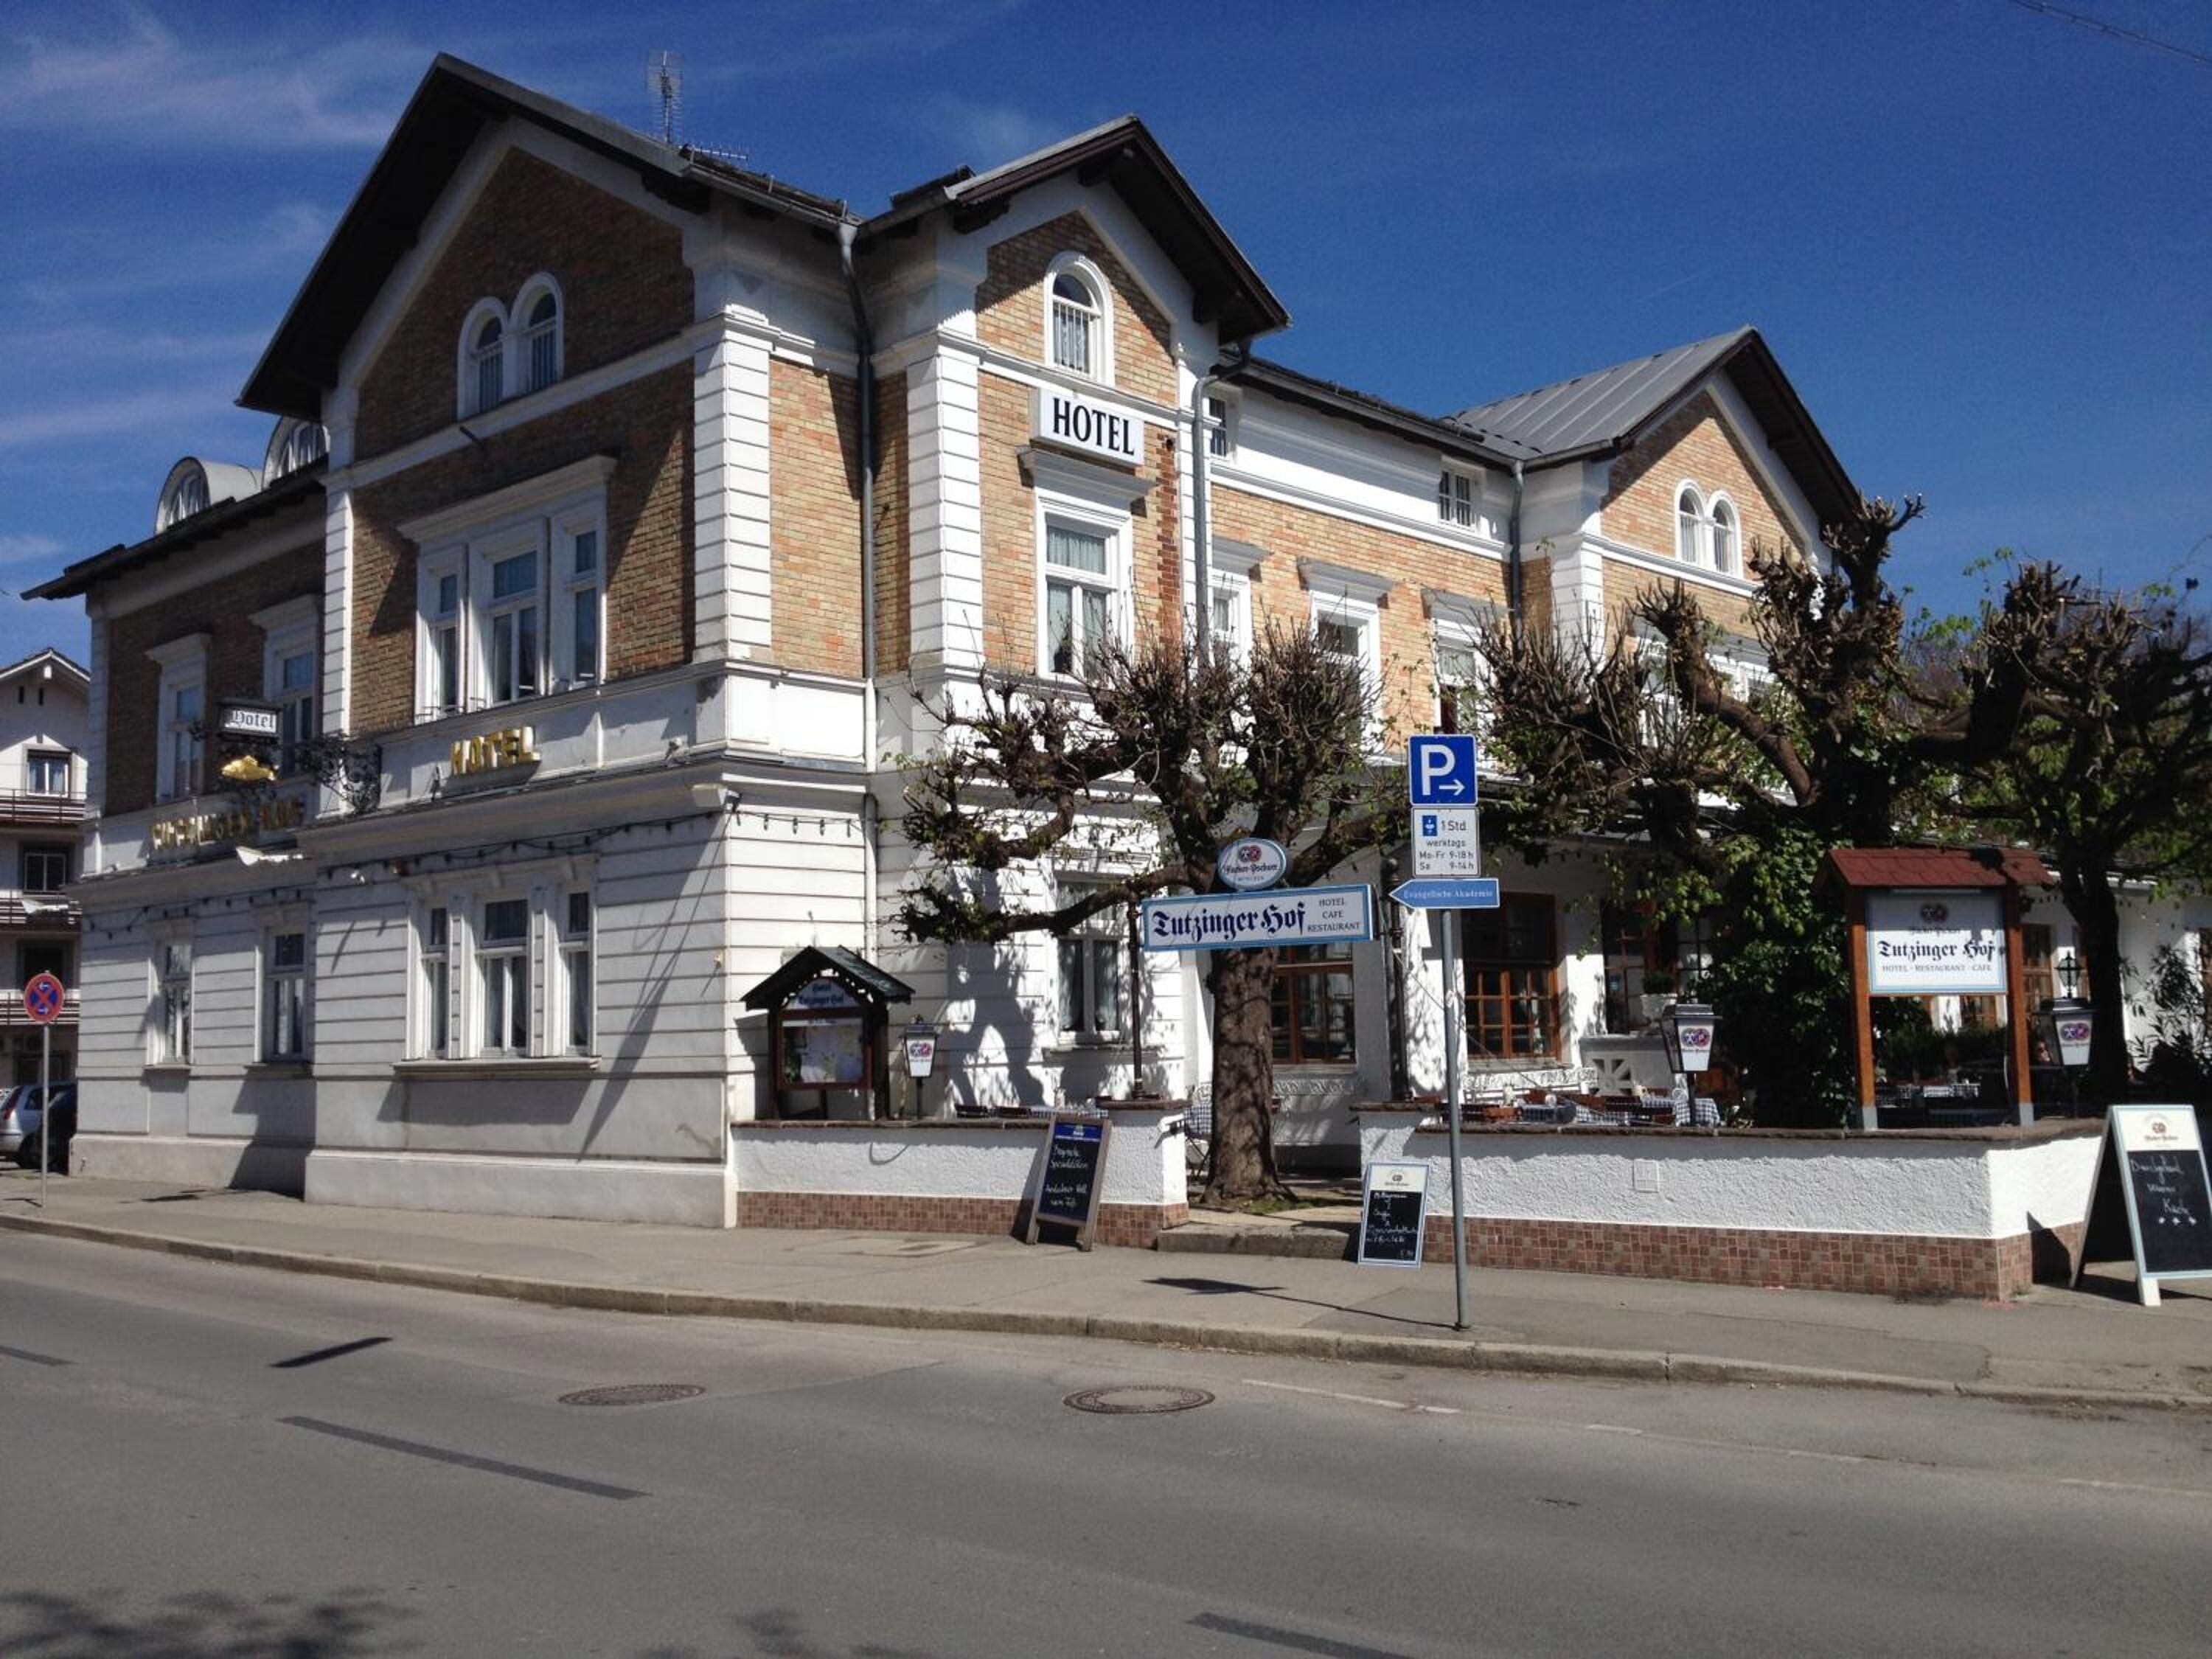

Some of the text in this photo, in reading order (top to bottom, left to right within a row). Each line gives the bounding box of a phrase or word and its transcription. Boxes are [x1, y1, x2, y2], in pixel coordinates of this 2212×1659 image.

[1053, 397, 1135, 456] HOTEL
[451, 726, 541, 776] HOTEL
[1420, 744, 1456, 796] P
[1426, 839, 1466, 849] werktags
[1419, 862, 1430, 870] Sa
[1318, 897, 1346, 907] HOTEL
[1152, 901, 1306, 943] Tutzinger Hof
[1307, 922, 1360, 933] RESTAURANT
[1878, 938, 1996, 962] Tutzinger Hof
[1882, 964, 1908, 973] HOTEL
[1914, 963, 1966, 972] RESTAURANT
